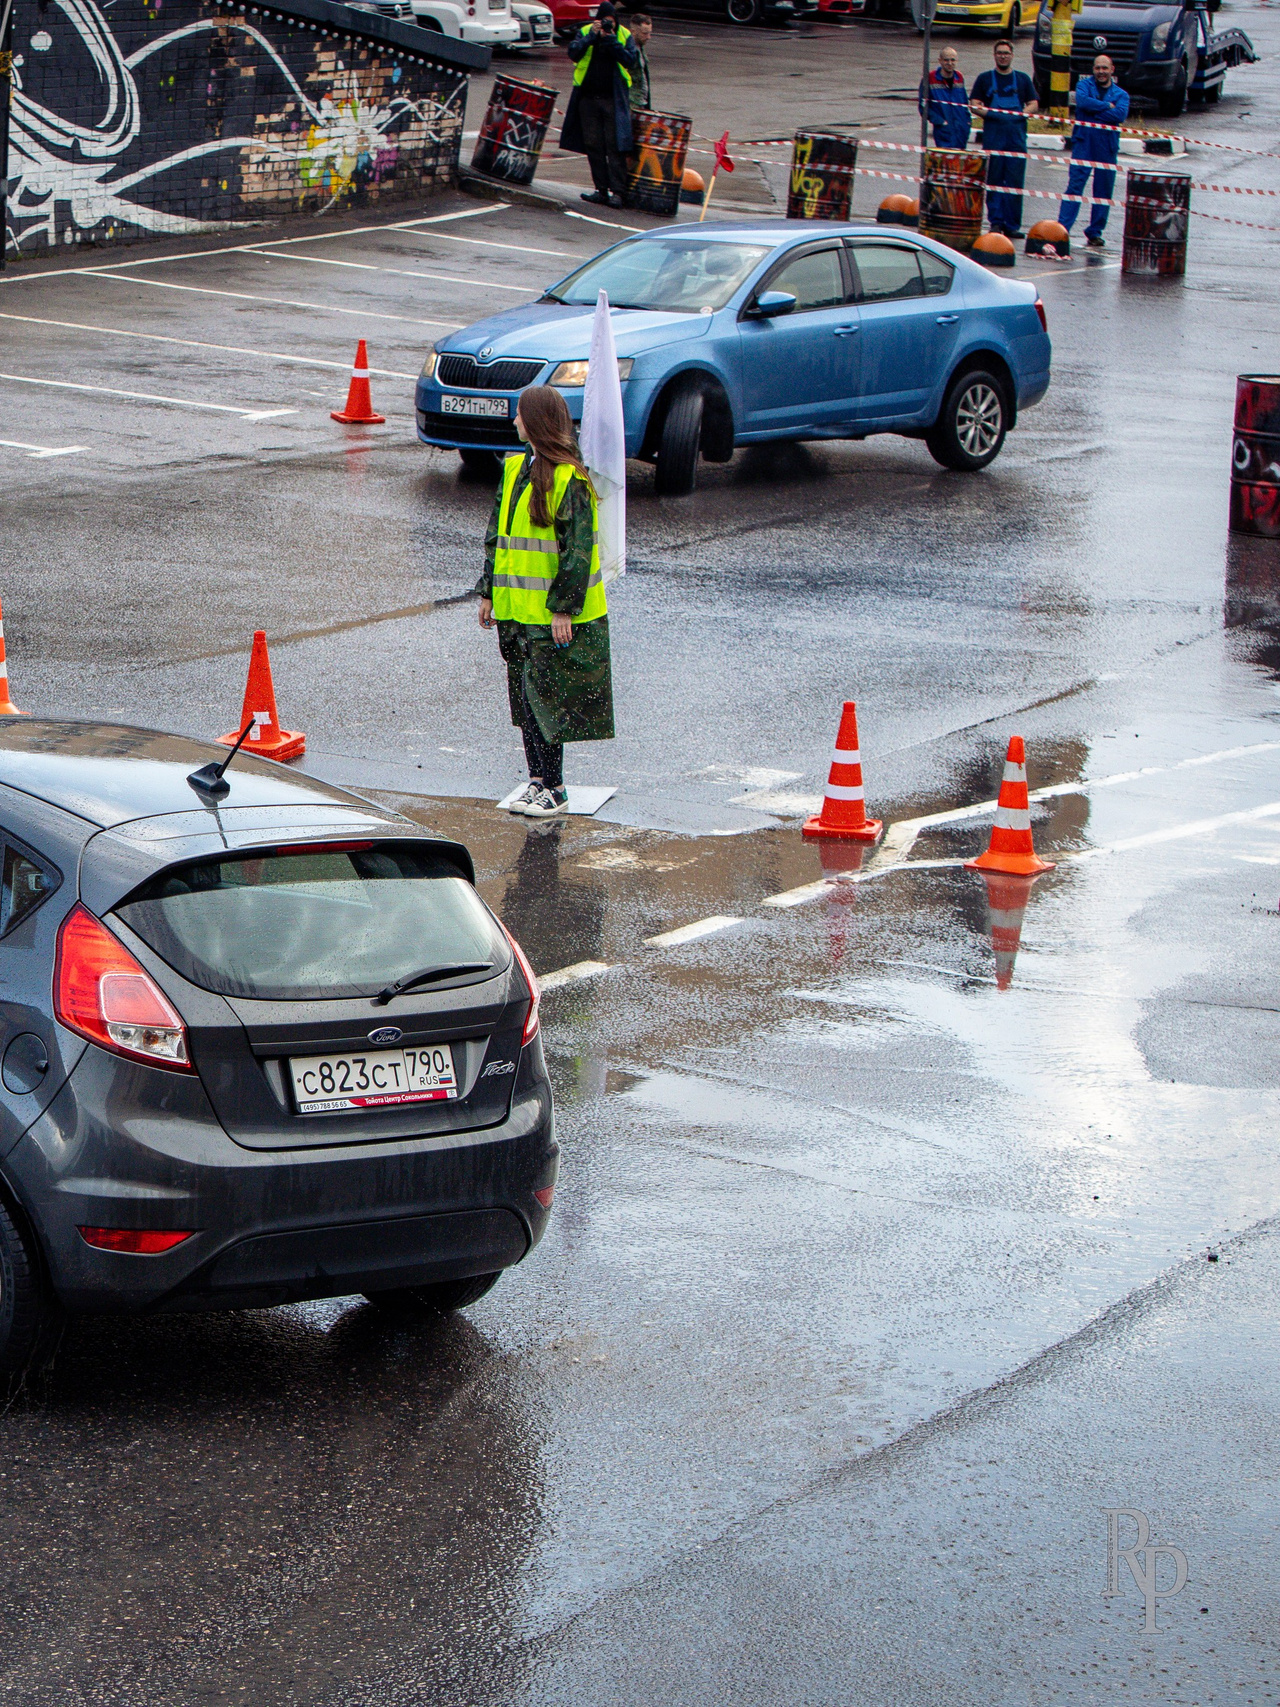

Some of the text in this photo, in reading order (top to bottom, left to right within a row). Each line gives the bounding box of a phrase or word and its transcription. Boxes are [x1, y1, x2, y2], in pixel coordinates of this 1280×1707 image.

[488, 399, 505, 412] 799
[375, 1030, 397, 1042] Ford
[302, 1049, 445, 1095] С823СТ 790
[481, 1059, 516, 1078] Fiesta
[419, 1075, 439, 1086] RUS
[364, 1093, 433, 1105] Тойота Центр Сокольники
[303, 1103, 319, 1112] (495)
